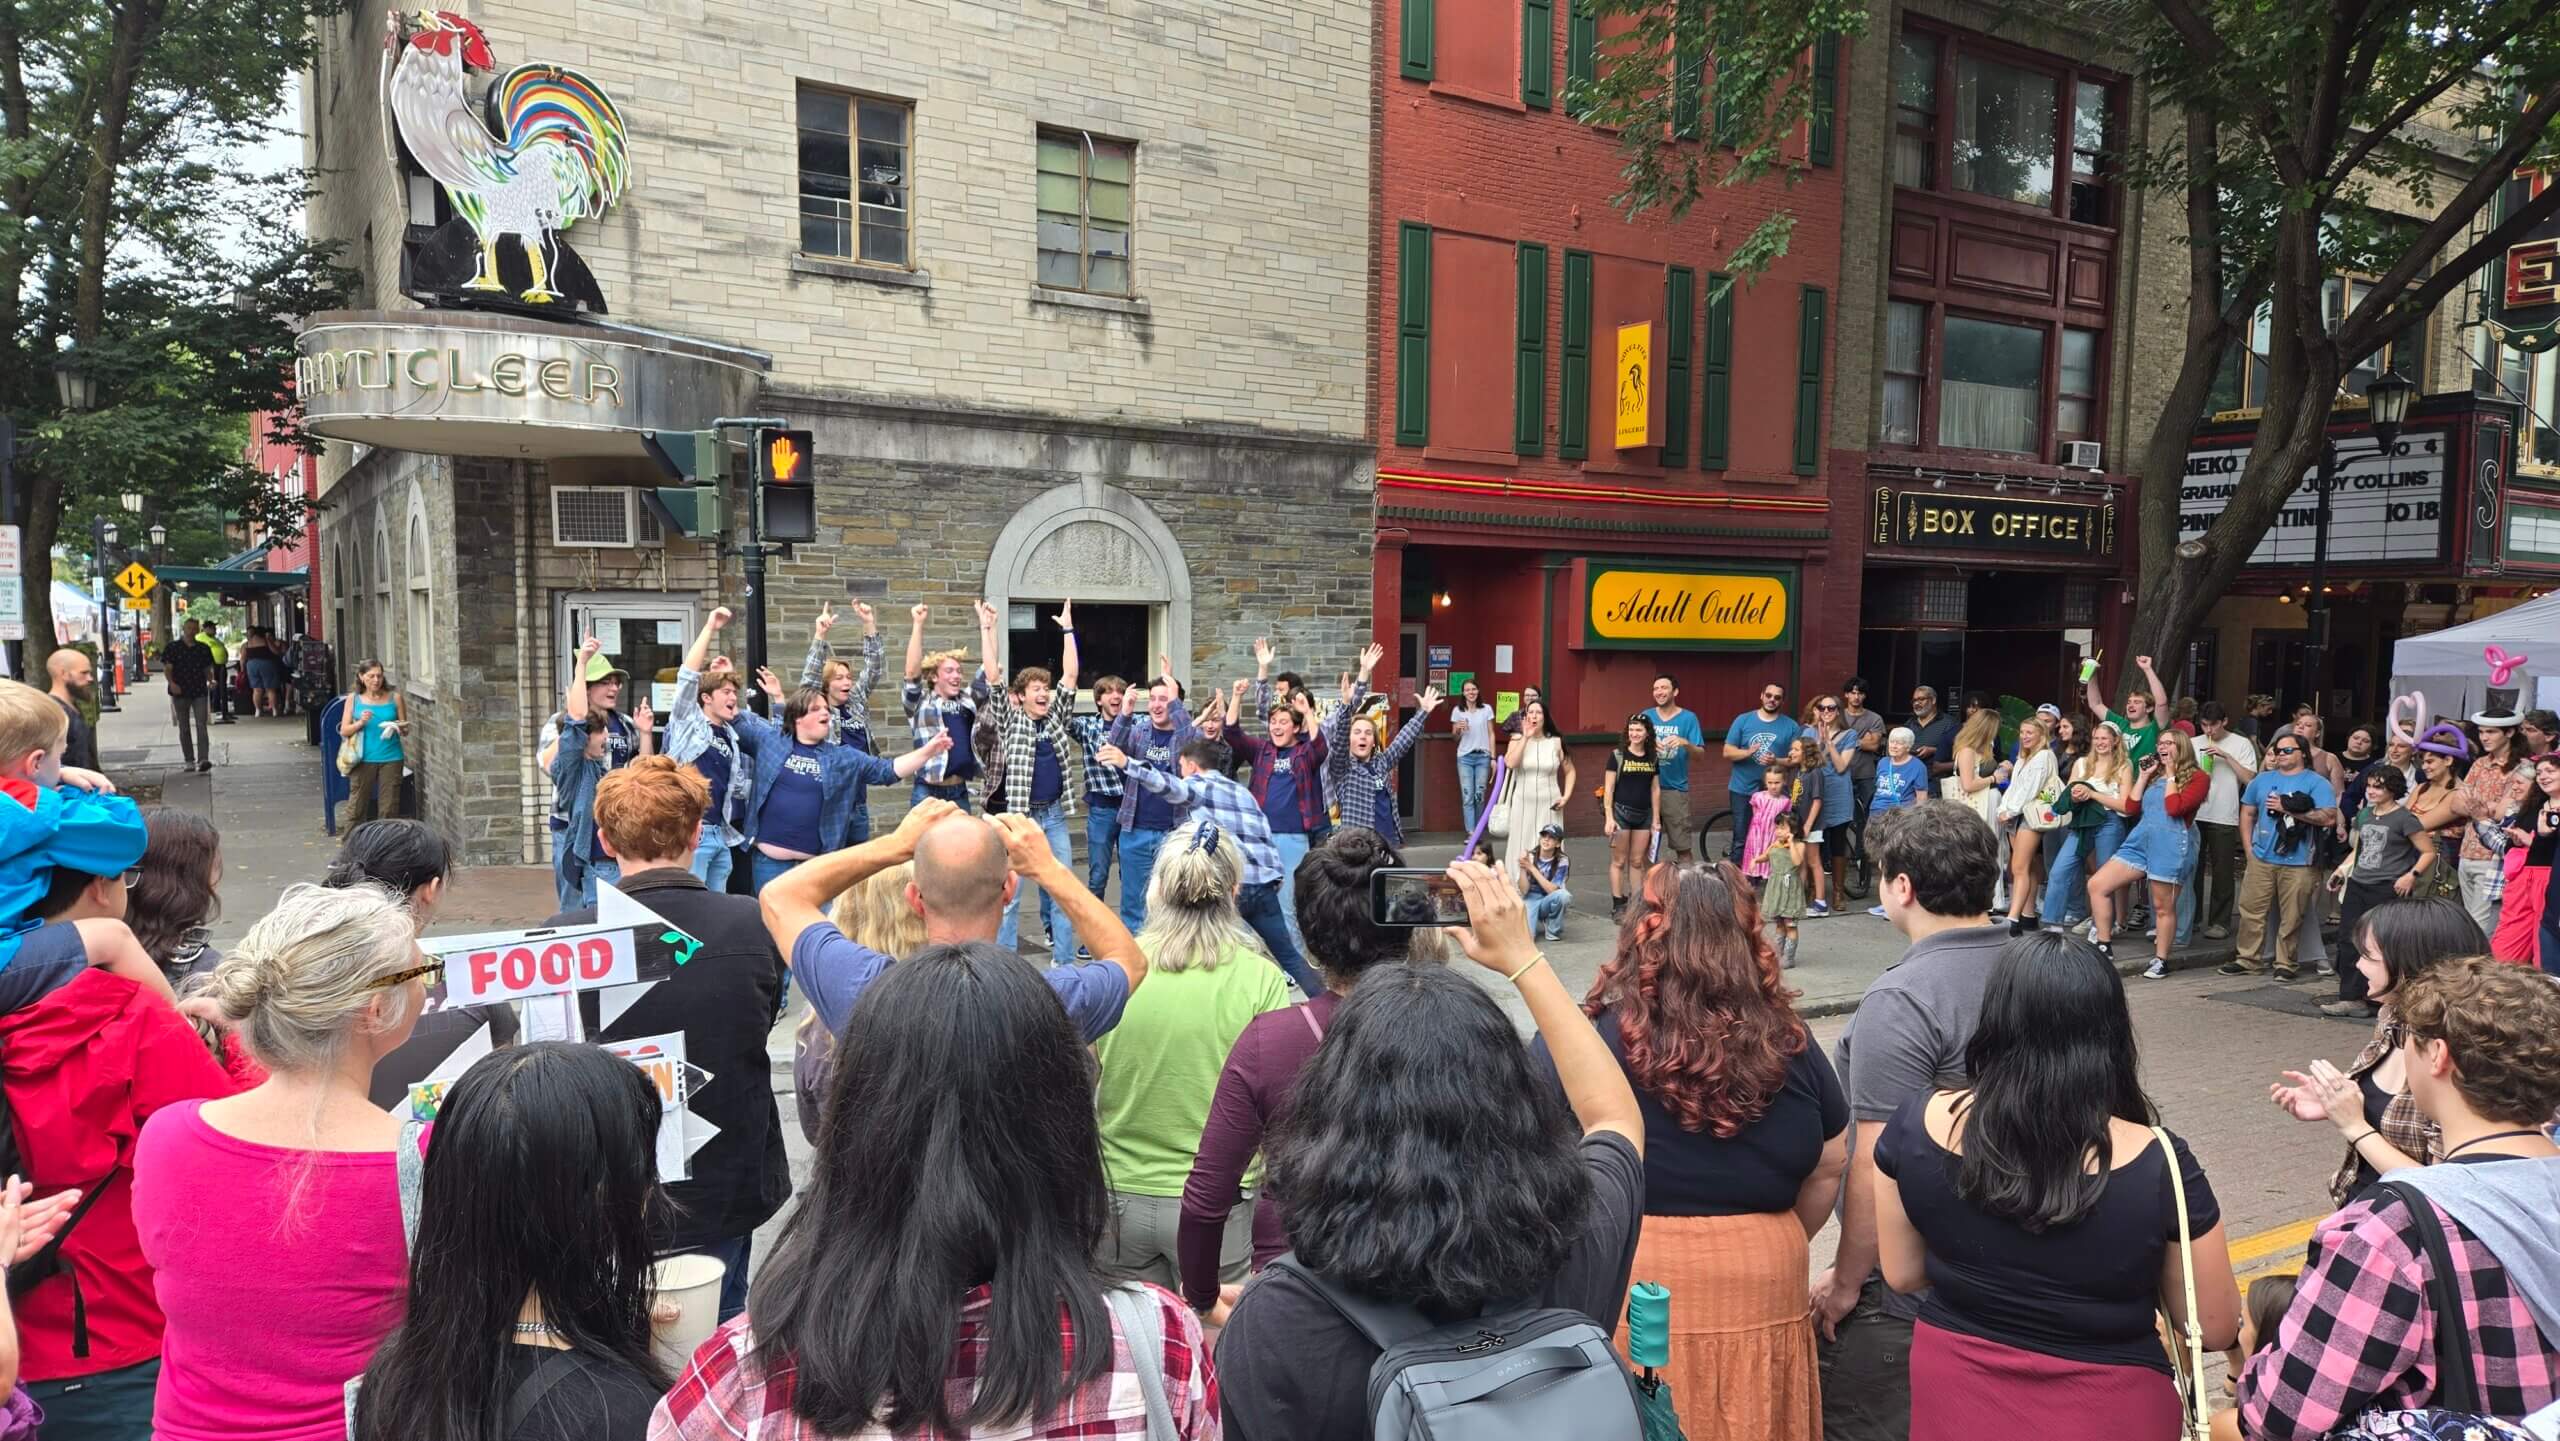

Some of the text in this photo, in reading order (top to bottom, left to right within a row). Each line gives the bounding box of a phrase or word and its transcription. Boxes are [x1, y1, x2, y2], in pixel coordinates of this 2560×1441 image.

[295, 346, 623, 406] ANTICLEER
[2424, 438, 2438, 455] 4
[2184, 455, 2238, 476] NEKO
[2352, 470, 2429, 491] COLLINS
[1878, 489, 1890, 543] STATE
[1923, 508, 2080, 541] BOX OFFICE
[2386, 501, 2439, 522] 10 18
[2105, 506, 2118, 555] STATE
[1607, 588, 1773, 625] Adult Outlet
[468, 937, 614, 996] FOOD
